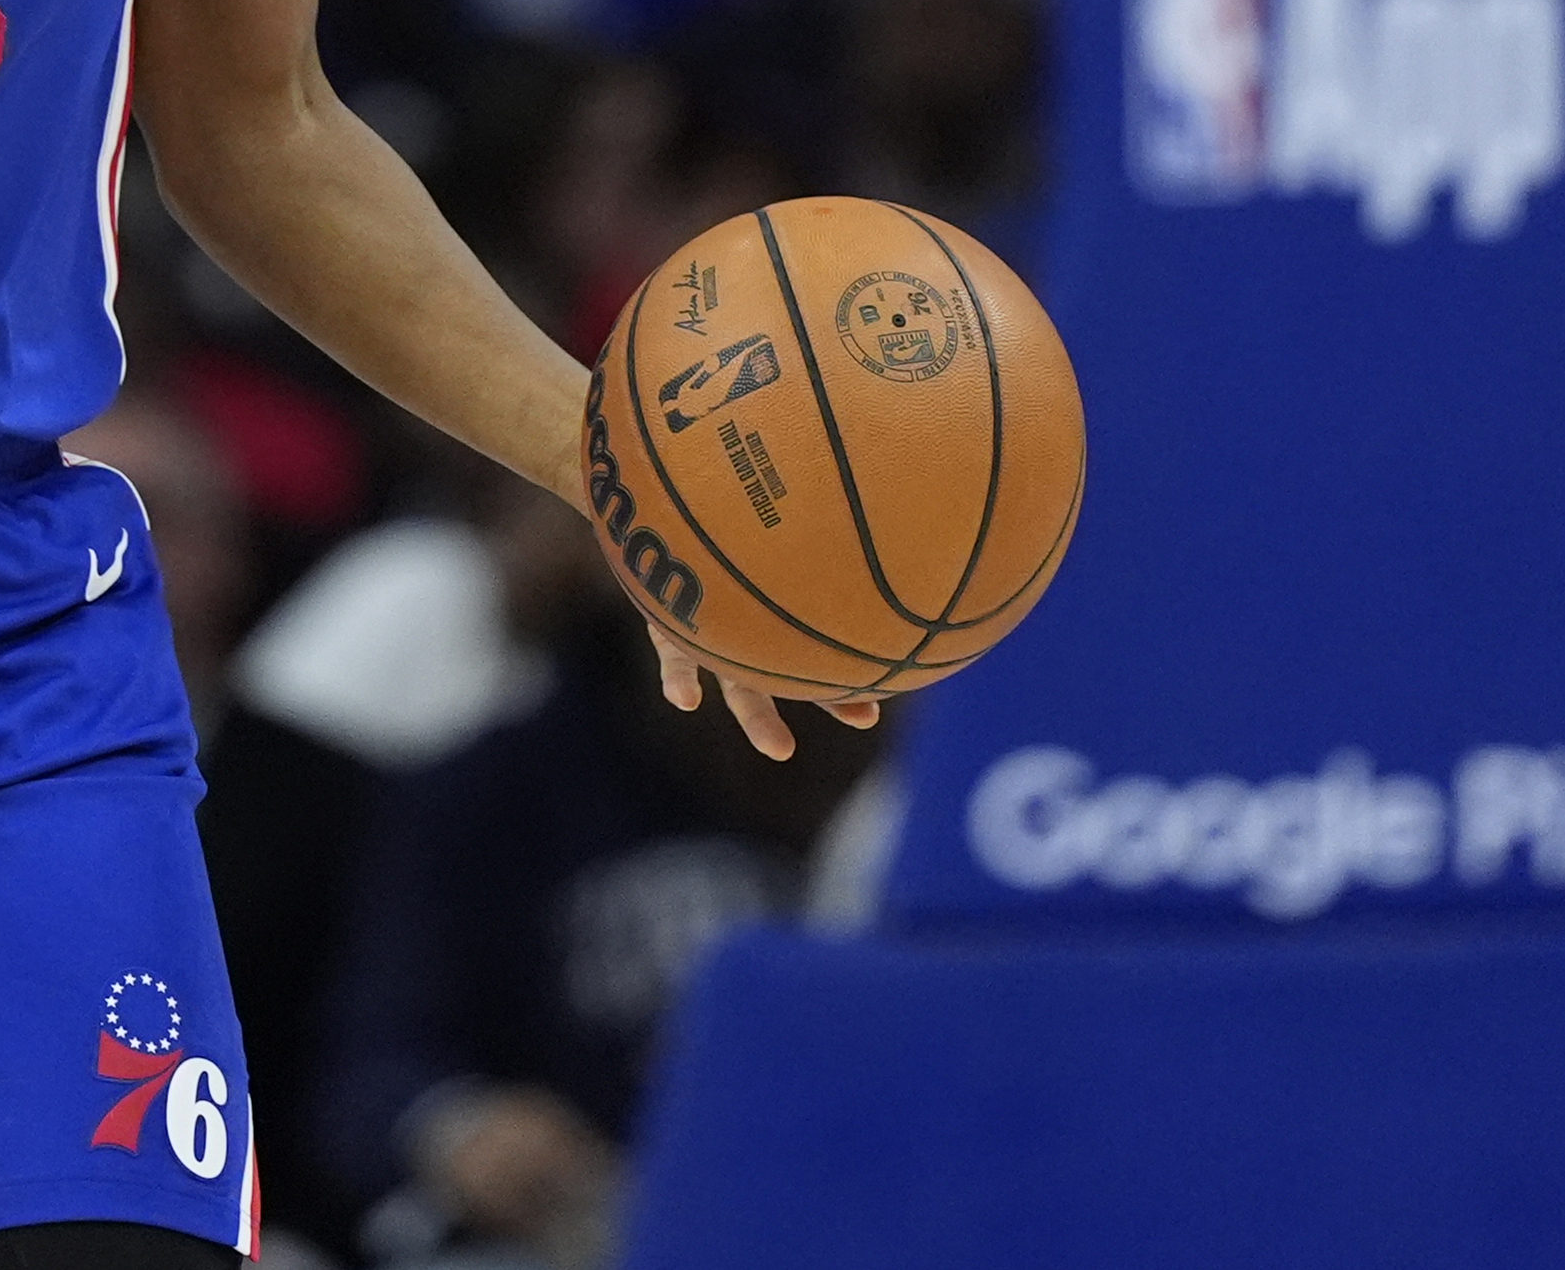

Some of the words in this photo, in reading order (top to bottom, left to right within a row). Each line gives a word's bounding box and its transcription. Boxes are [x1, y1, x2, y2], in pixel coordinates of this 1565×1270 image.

[717, 419, 742, 451] BALL
[729, 447, 757, 482] GAME
[744, 478, 782, 529] OFFICIAL
[966, 744, 1446, 922] Google
[91, 1030, 228, 1179] 76
